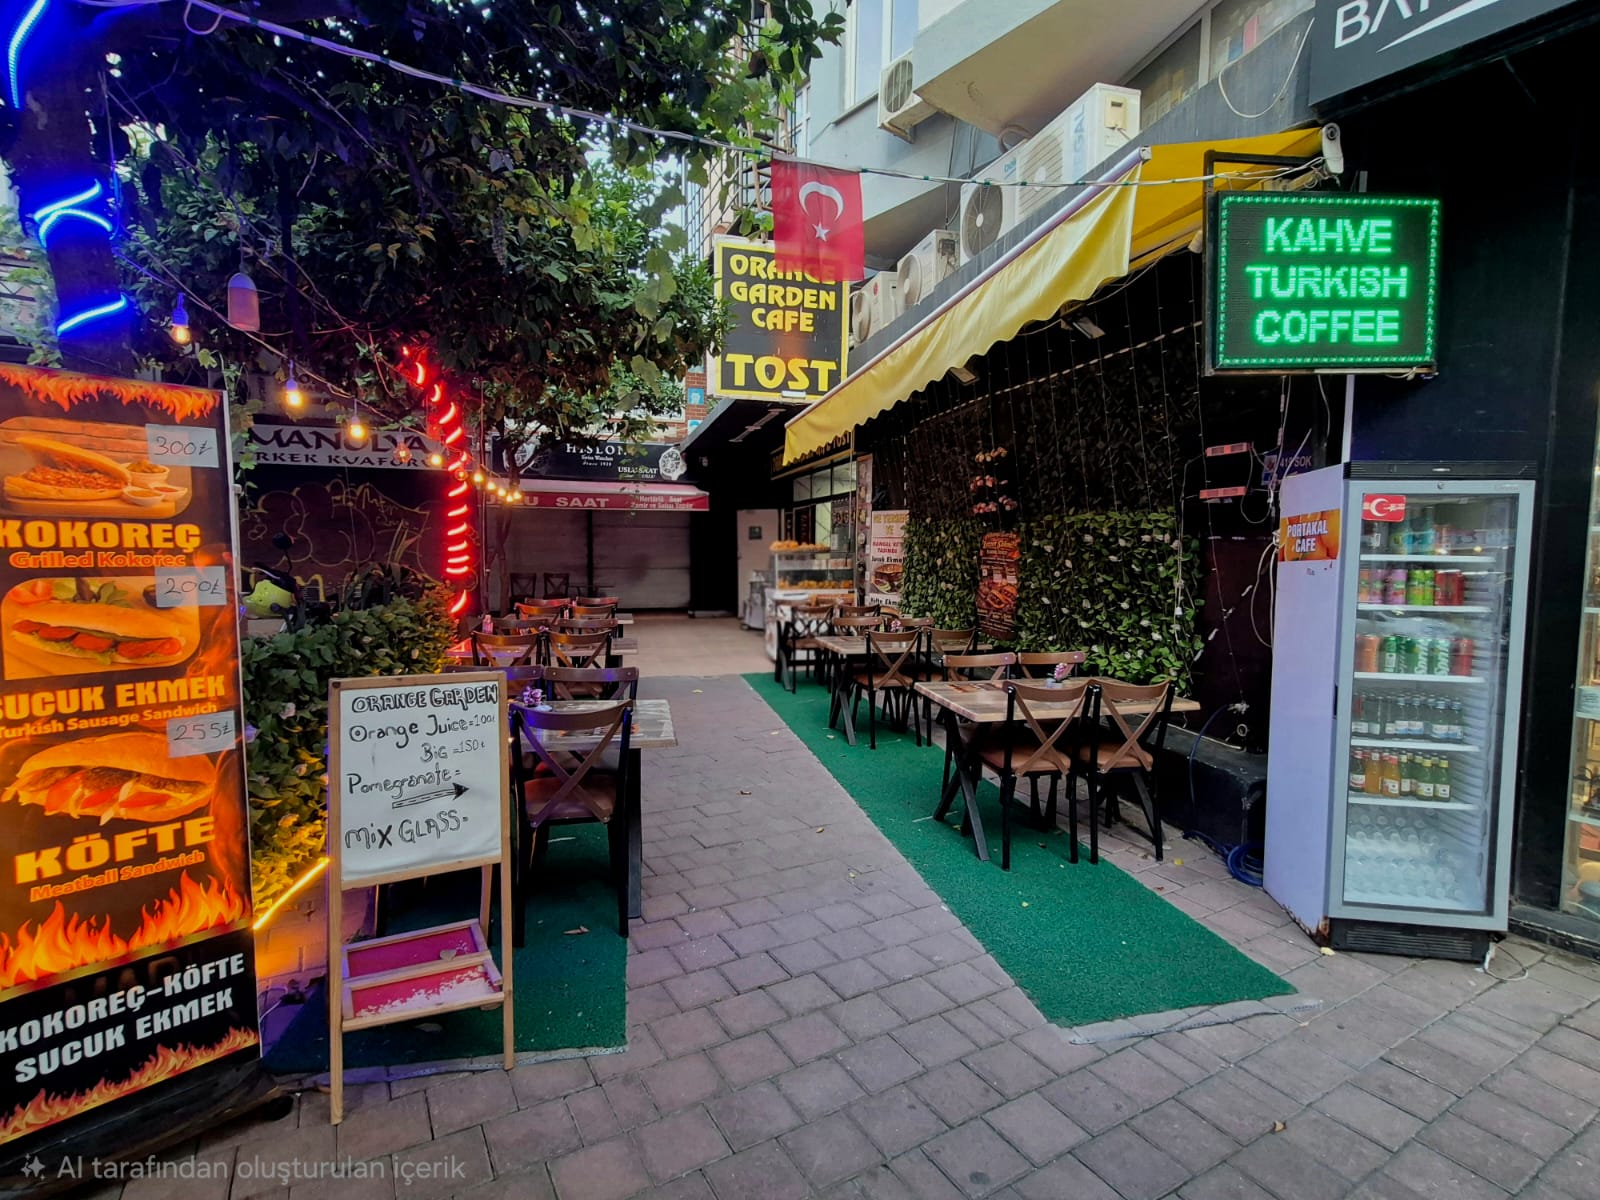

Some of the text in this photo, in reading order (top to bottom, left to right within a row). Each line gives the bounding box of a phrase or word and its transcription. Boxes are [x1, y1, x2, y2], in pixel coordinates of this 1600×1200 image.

[1265, 217, 1392, 252] KAHVE
[730, 255, 836, 285] ORANGE
[1245, 265, 1408, 298] TURKISH
[729, 281, 836, 310] GARDEN
[752, 308, 814, 332] CAFE
[1255, 310, 1400, 343] COFFEE
[726, 354, 837, 391] TOST
[240, 452, 318, 463] RKEK
[556, 497, 609, 508] SAAT
[1287, 520, 1328, 536] PORTAKAL
[9, 551, 96, 568] Grilled
[1295, 538, 1316, 553] CAFE
[0, 675, 225, 721] UCUK EKMEK
[352, 684, 498, 713] ORANGE GARDEN
[67, 712, 139, 732] Sausage
[143, 702, 217, 722] Sandwich
[349, 722, 419, 749] Orange
[14, 815, 216, 884] KÖFTE
[30, 850, 205, 902] Meatball Sandwich
[15, 987, 233, 1083] SUCUK EKMEK
